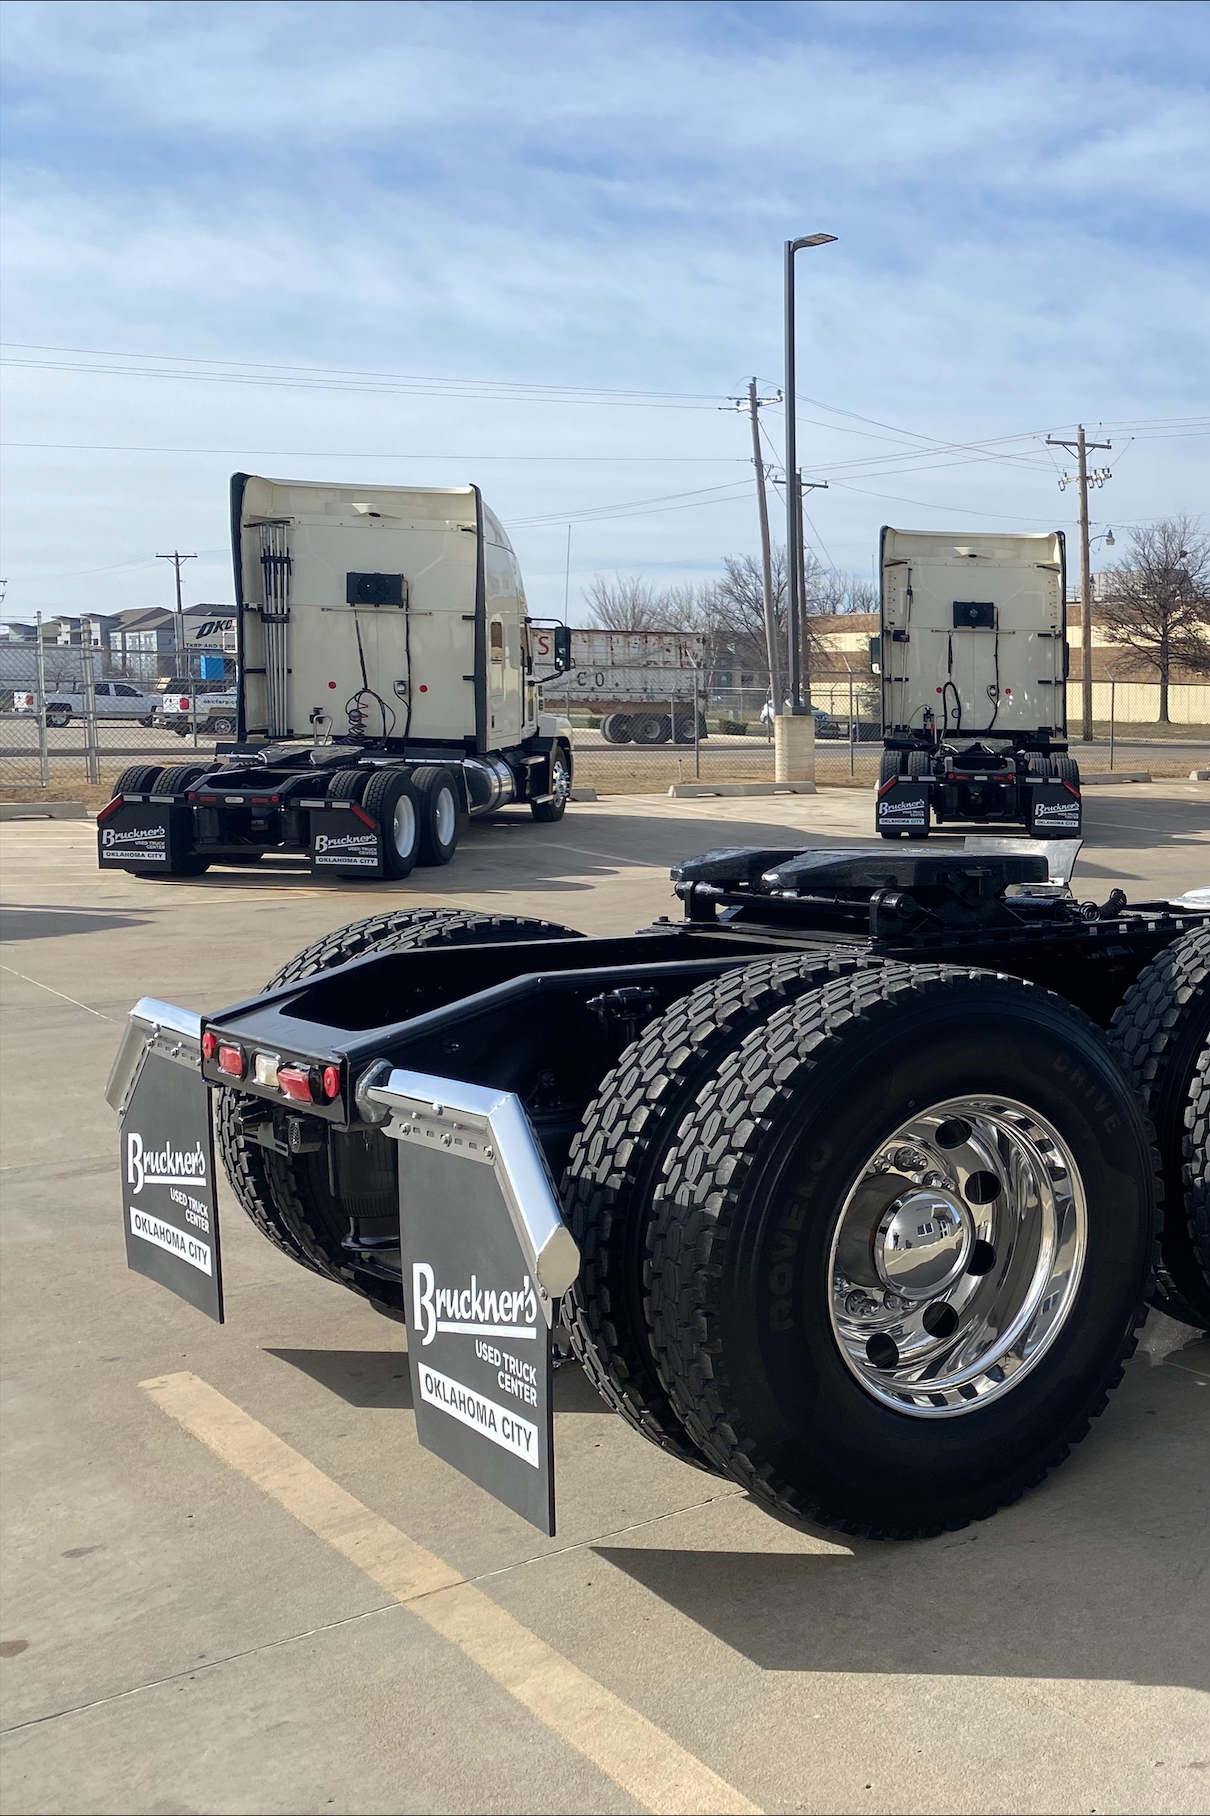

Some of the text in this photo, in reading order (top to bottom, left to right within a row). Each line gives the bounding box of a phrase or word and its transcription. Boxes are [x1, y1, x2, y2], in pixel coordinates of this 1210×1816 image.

[879, 799, 925, 816] Bruckner's
[1035, 801, 1079, 817] Bruckner's
[102, 826, 165, 848] Bruckner's
[315, 833, 377, 853] Bruckner's
[1051, 1050, 1122, 1134] DRIVE
[127, 1132, 207, 1194] Bruckner's
[169, 1187, 208, 1219] USED TRUCK
[185, 1208, 209, 1233] CENTER
[134, 1214, 208, 1266] OKLAHOMA CITY
[769, 1139, 834, 1334] ROVELO
[412, 1262, 538, 1346] Bruckner's
[475, 1339, 537, 1387] USED TRUCK
[497, 1370, 538, 1408] CENTER
[424, 1373, 532, 1452] OKLAHOMA CITY
